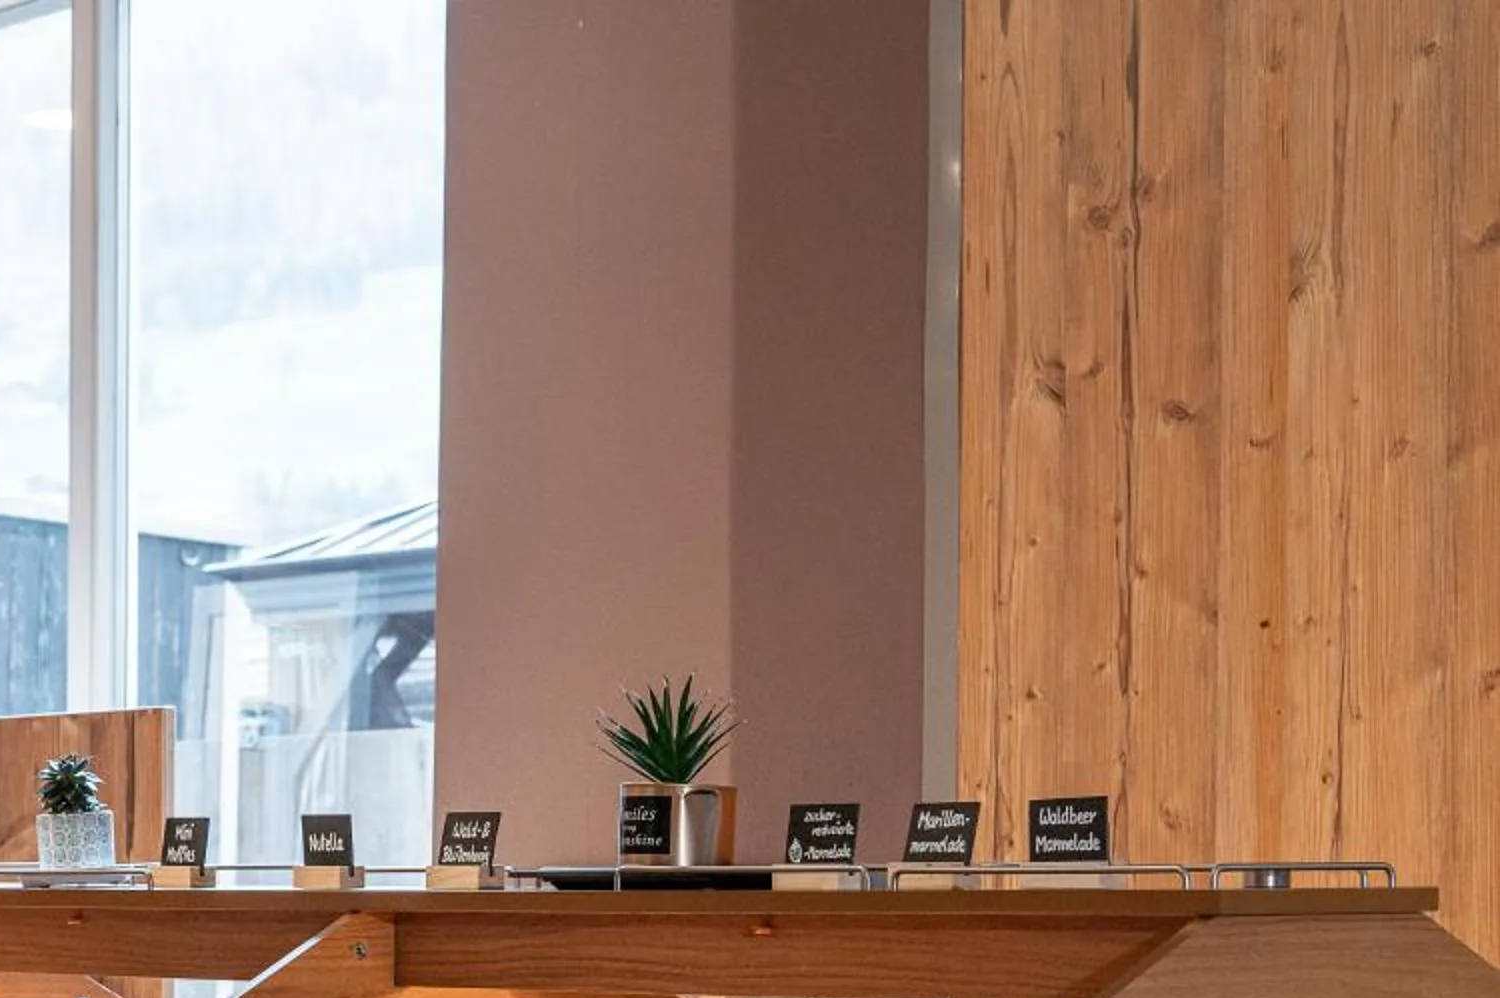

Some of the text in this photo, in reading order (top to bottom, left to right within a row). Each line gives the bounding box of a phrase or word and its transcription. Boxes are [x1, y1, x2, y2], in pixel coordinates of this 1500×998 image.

[1039, 805, 1097, 826] Waldbeer
[309, 832, 345, 852] Nutella
[1035, 832, 1101, 854] Marmelade
